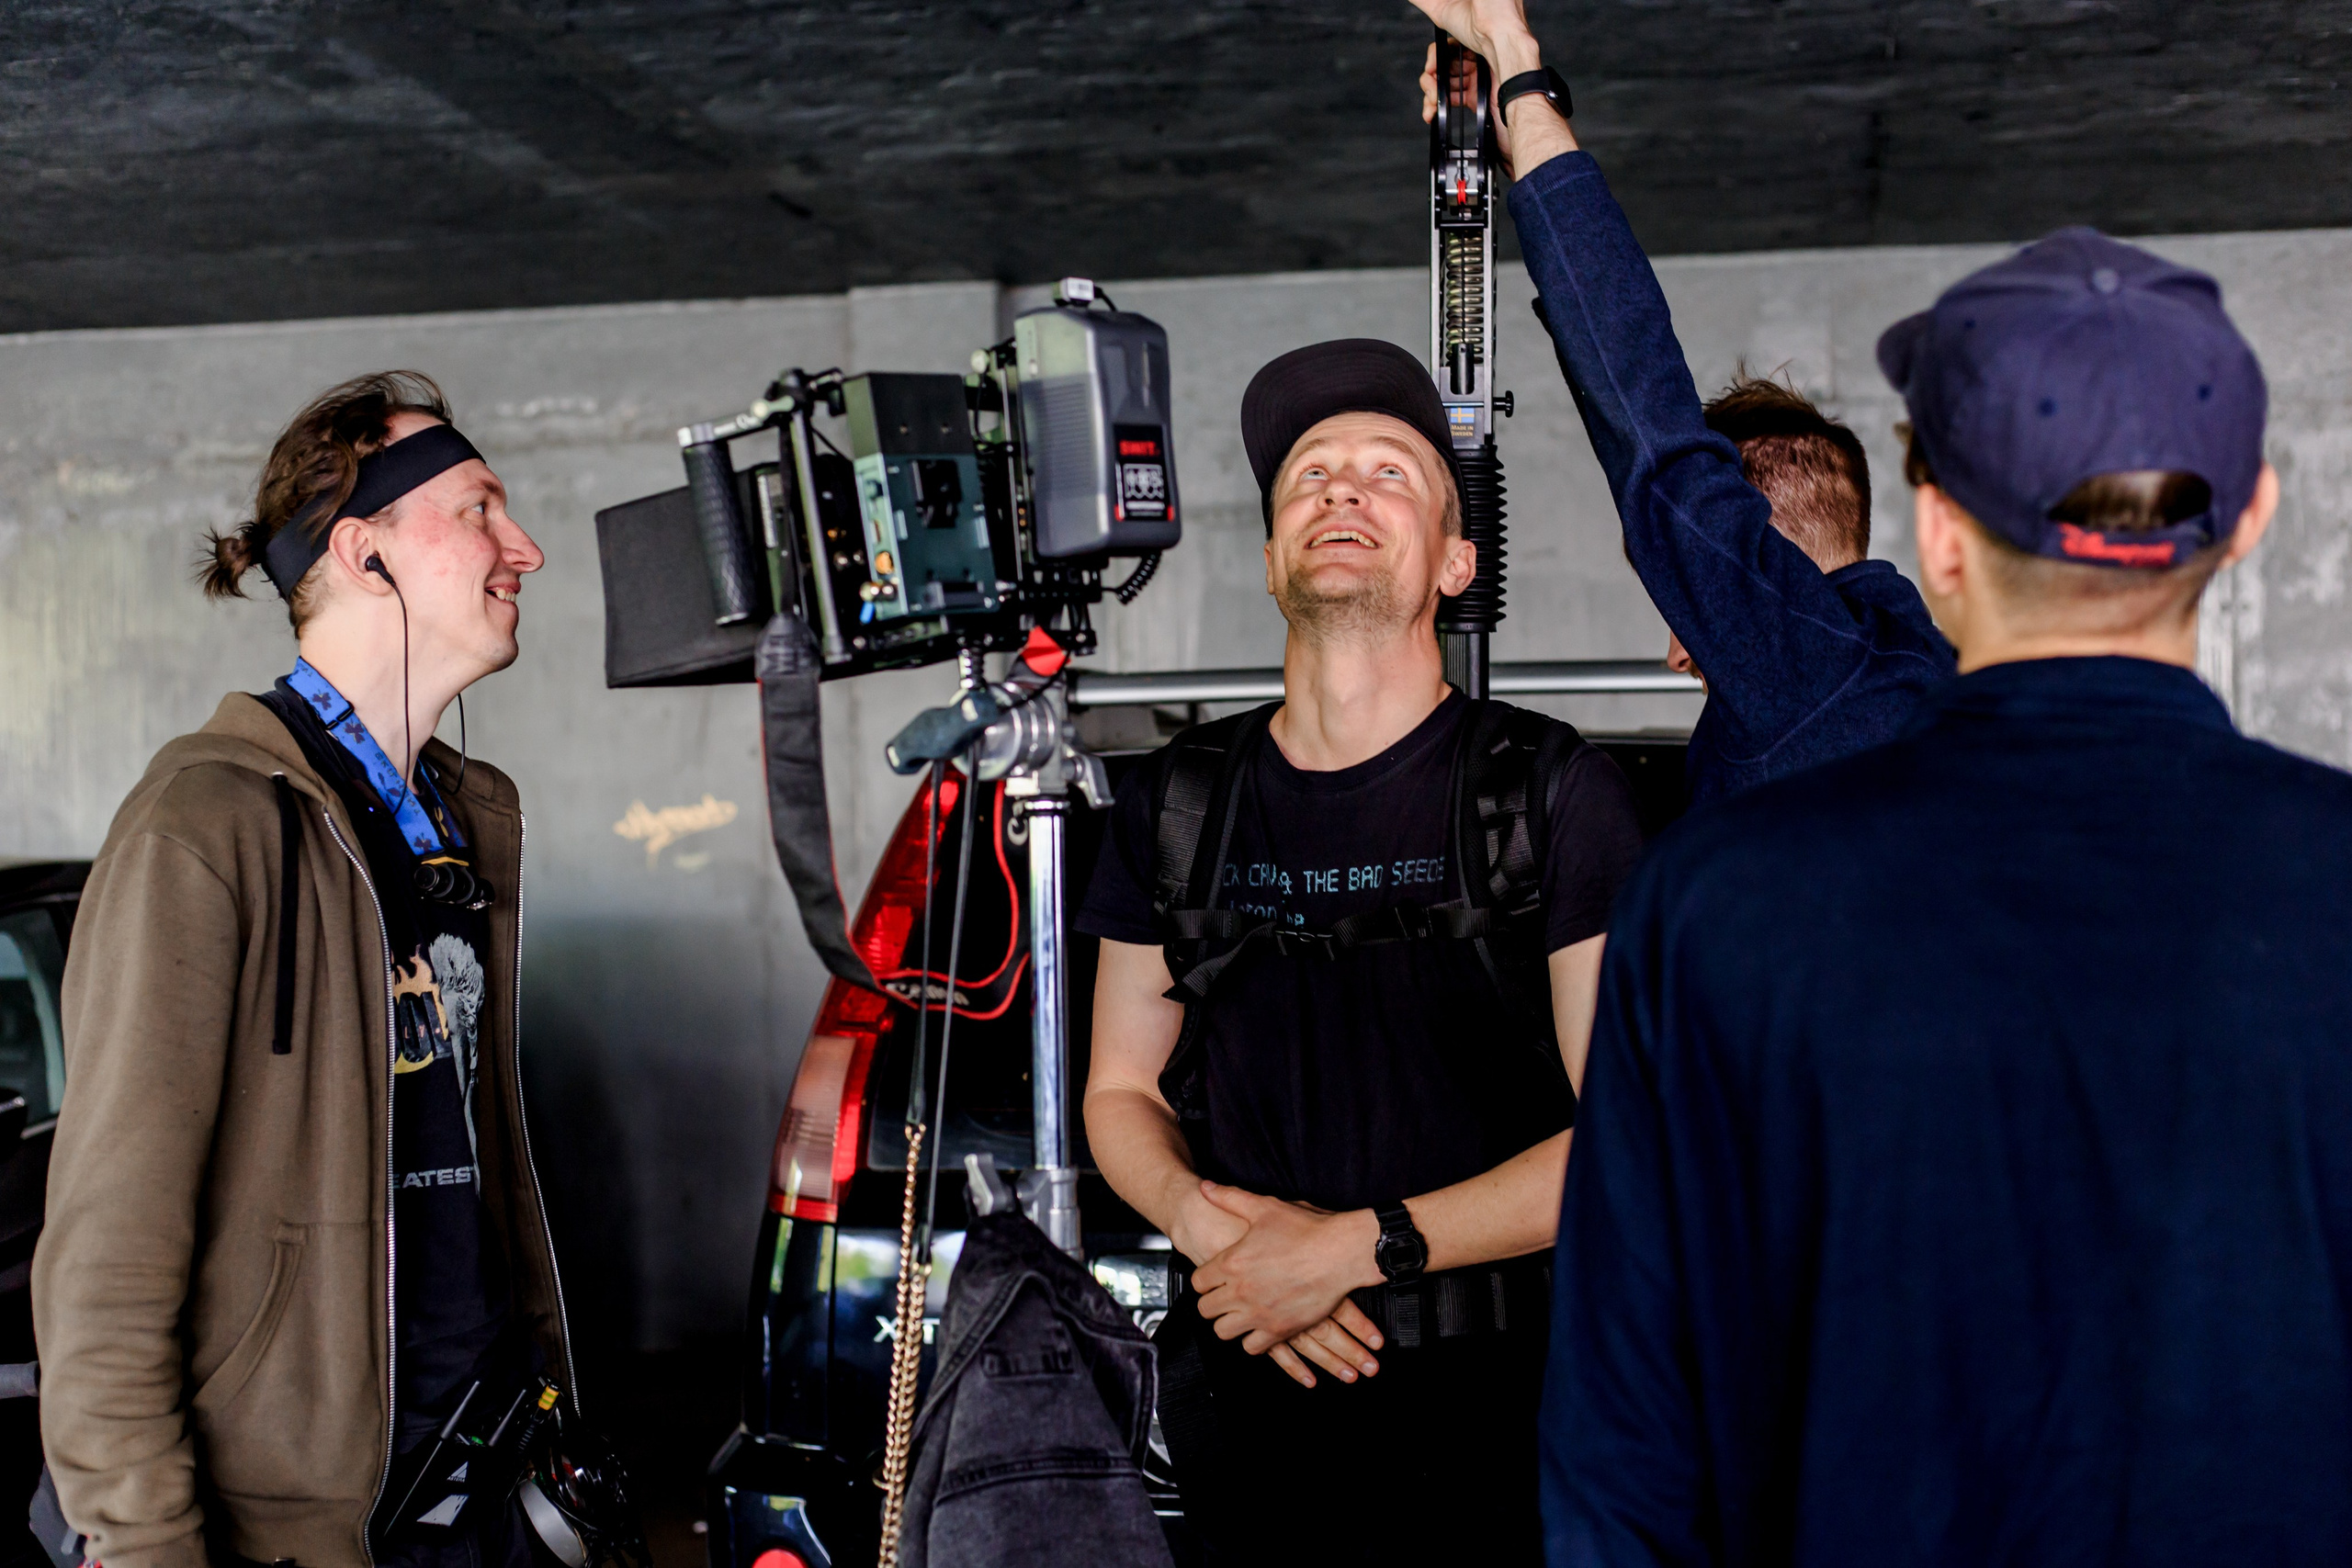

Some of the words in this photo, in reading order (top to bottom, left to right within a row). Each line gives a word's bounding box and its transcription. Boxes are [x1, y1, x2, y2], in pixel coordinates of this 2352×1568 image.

[1249, 863, 1277, 886] CAV
[1304, 869, 1340, 893] THE
[1348, 864, 1384, 891] BAD
